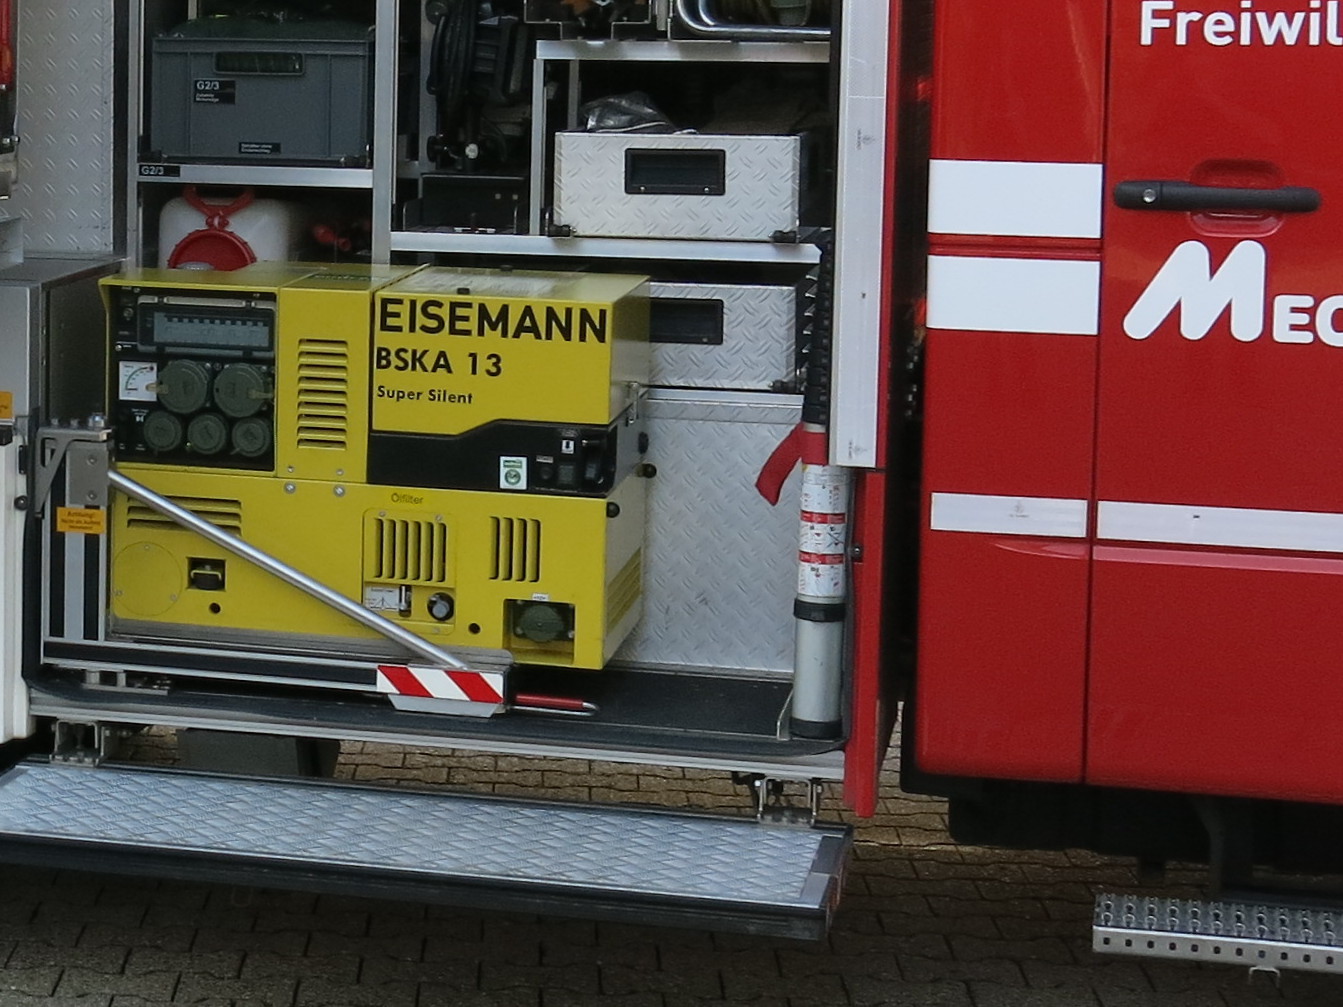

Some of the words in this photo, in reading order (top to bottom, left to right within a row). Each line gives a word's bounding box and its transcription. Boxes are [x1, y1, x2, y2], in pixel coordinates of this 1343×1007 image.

[1140, 0, 1343, 46] Freiwil
[196, 80, 220, 91] G2/3
[141, 165, 164, 175] G2/3
[379, 297, 607, 343] EISEMANN
[376, 346, 453, 374] BSKA
[468, 352, 503, 377] 13
[377, 385, 423, 402] Super
[428, 388, 473, 404] Silent
